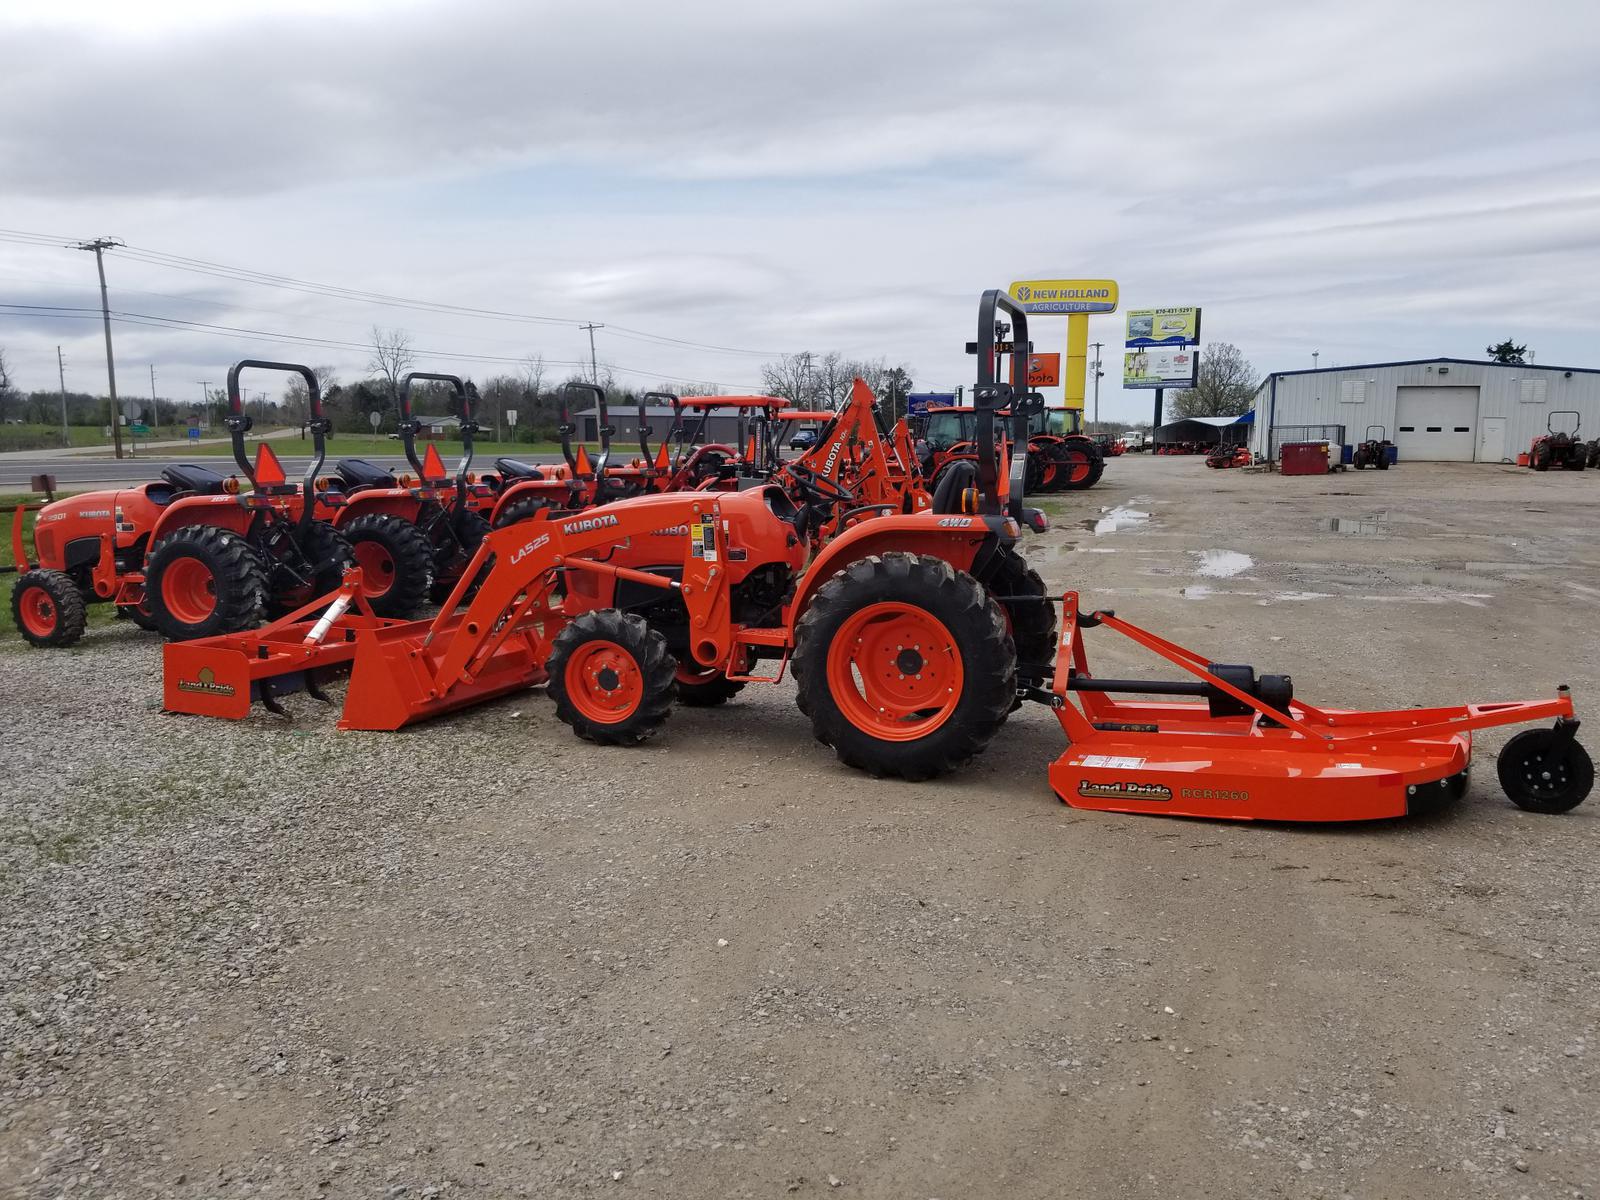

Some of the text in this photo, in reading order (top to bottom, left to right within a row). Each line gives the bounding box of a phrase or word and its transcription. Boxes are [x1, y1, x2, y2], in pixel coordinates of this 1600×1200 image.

[1033, 289, 1109, 299] NEW HOLLAND
[1032, 303, 1091, 311] AGRICULTURE
[79, 510, 111, 518] KUBOTA
[563, 514, 619, 536] KUBOTA
[937, 518, 972, 527] 4WD
[650, 524, 689, 536] KUBO
[510, 533, 550, 565] LA525
[1080, 780, 1170, 796] Land Pride
[1181, 788, 1249, 801] RCR1260
